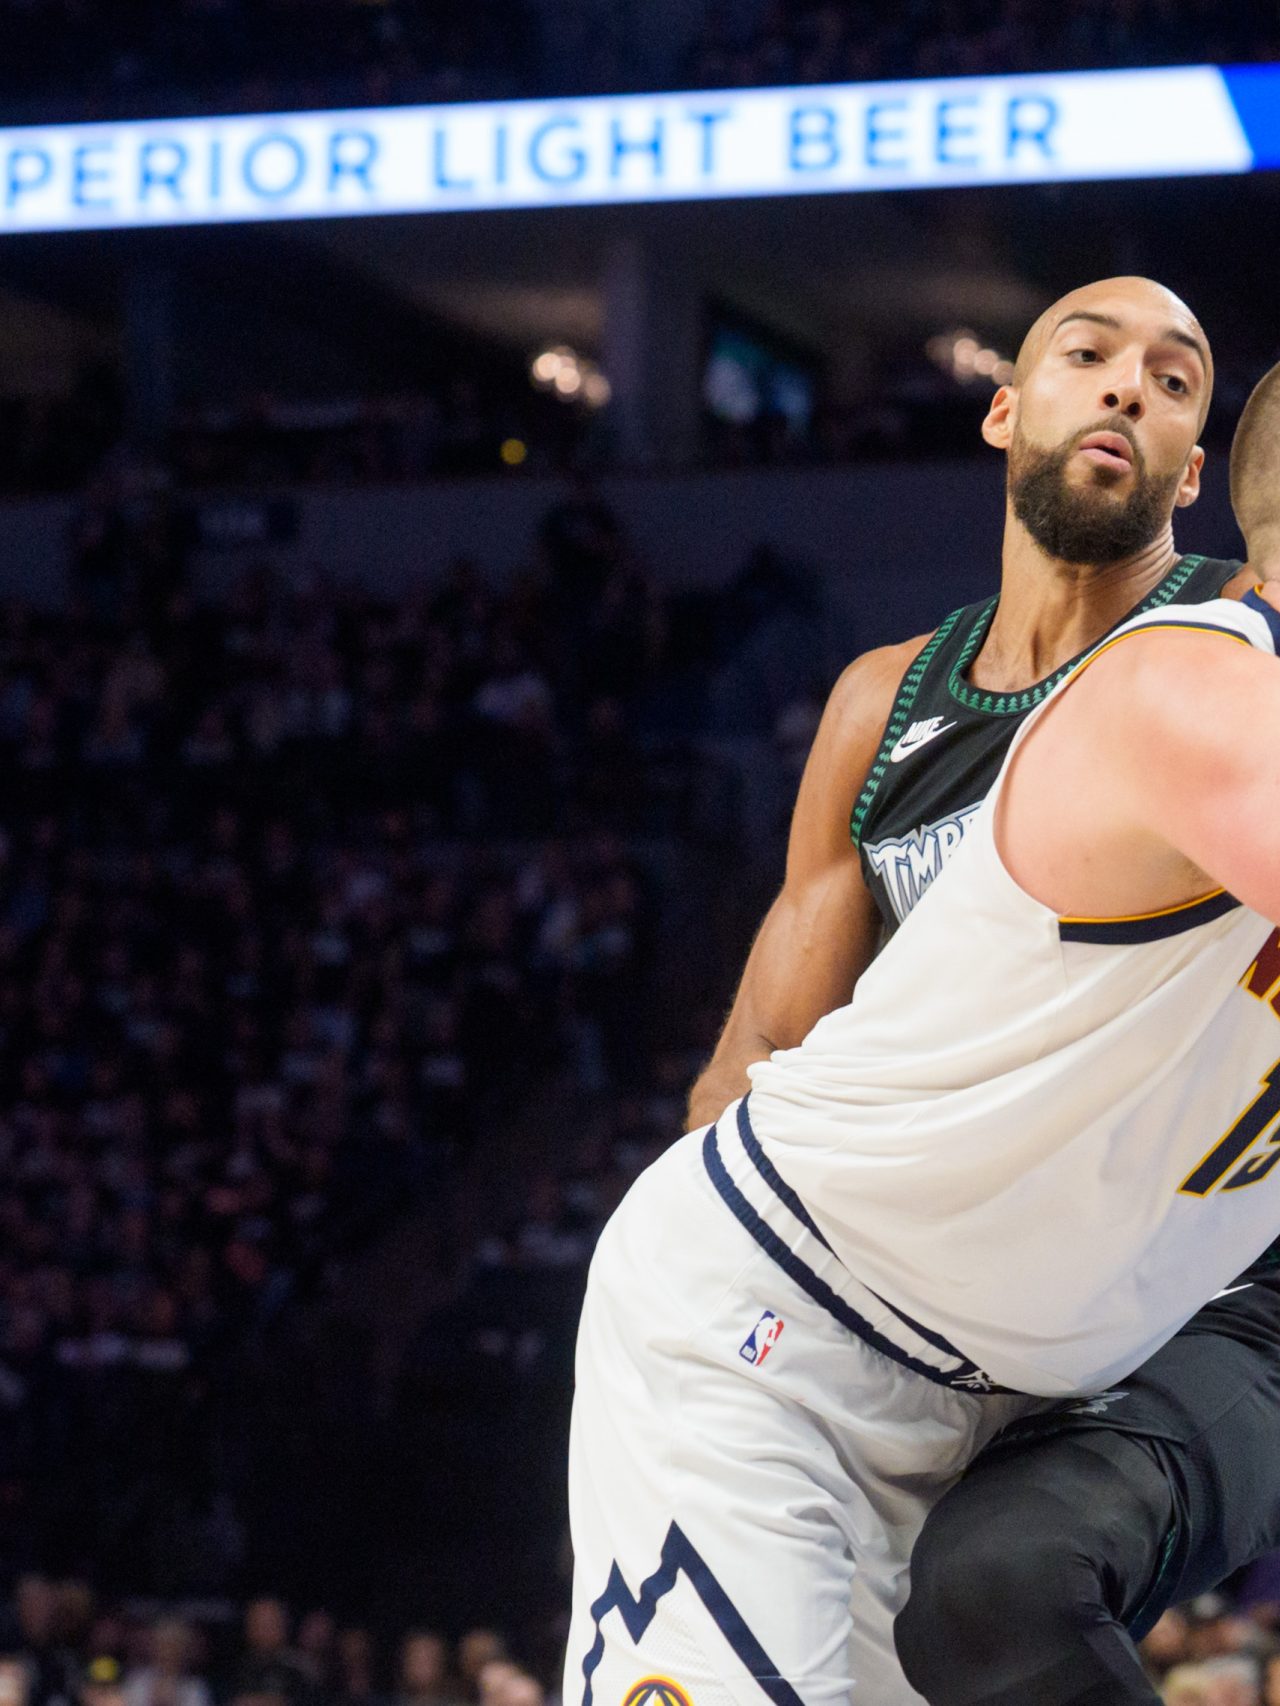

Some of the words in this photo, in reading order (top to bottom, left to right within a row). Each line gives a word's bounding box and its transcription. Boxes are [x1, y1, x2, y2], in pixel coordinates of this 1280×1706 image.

[4, 130, 383, 208] PERIOR
[433, 108, 730, 189] LIGHT
[788, 92, 1060, 172] BEER
